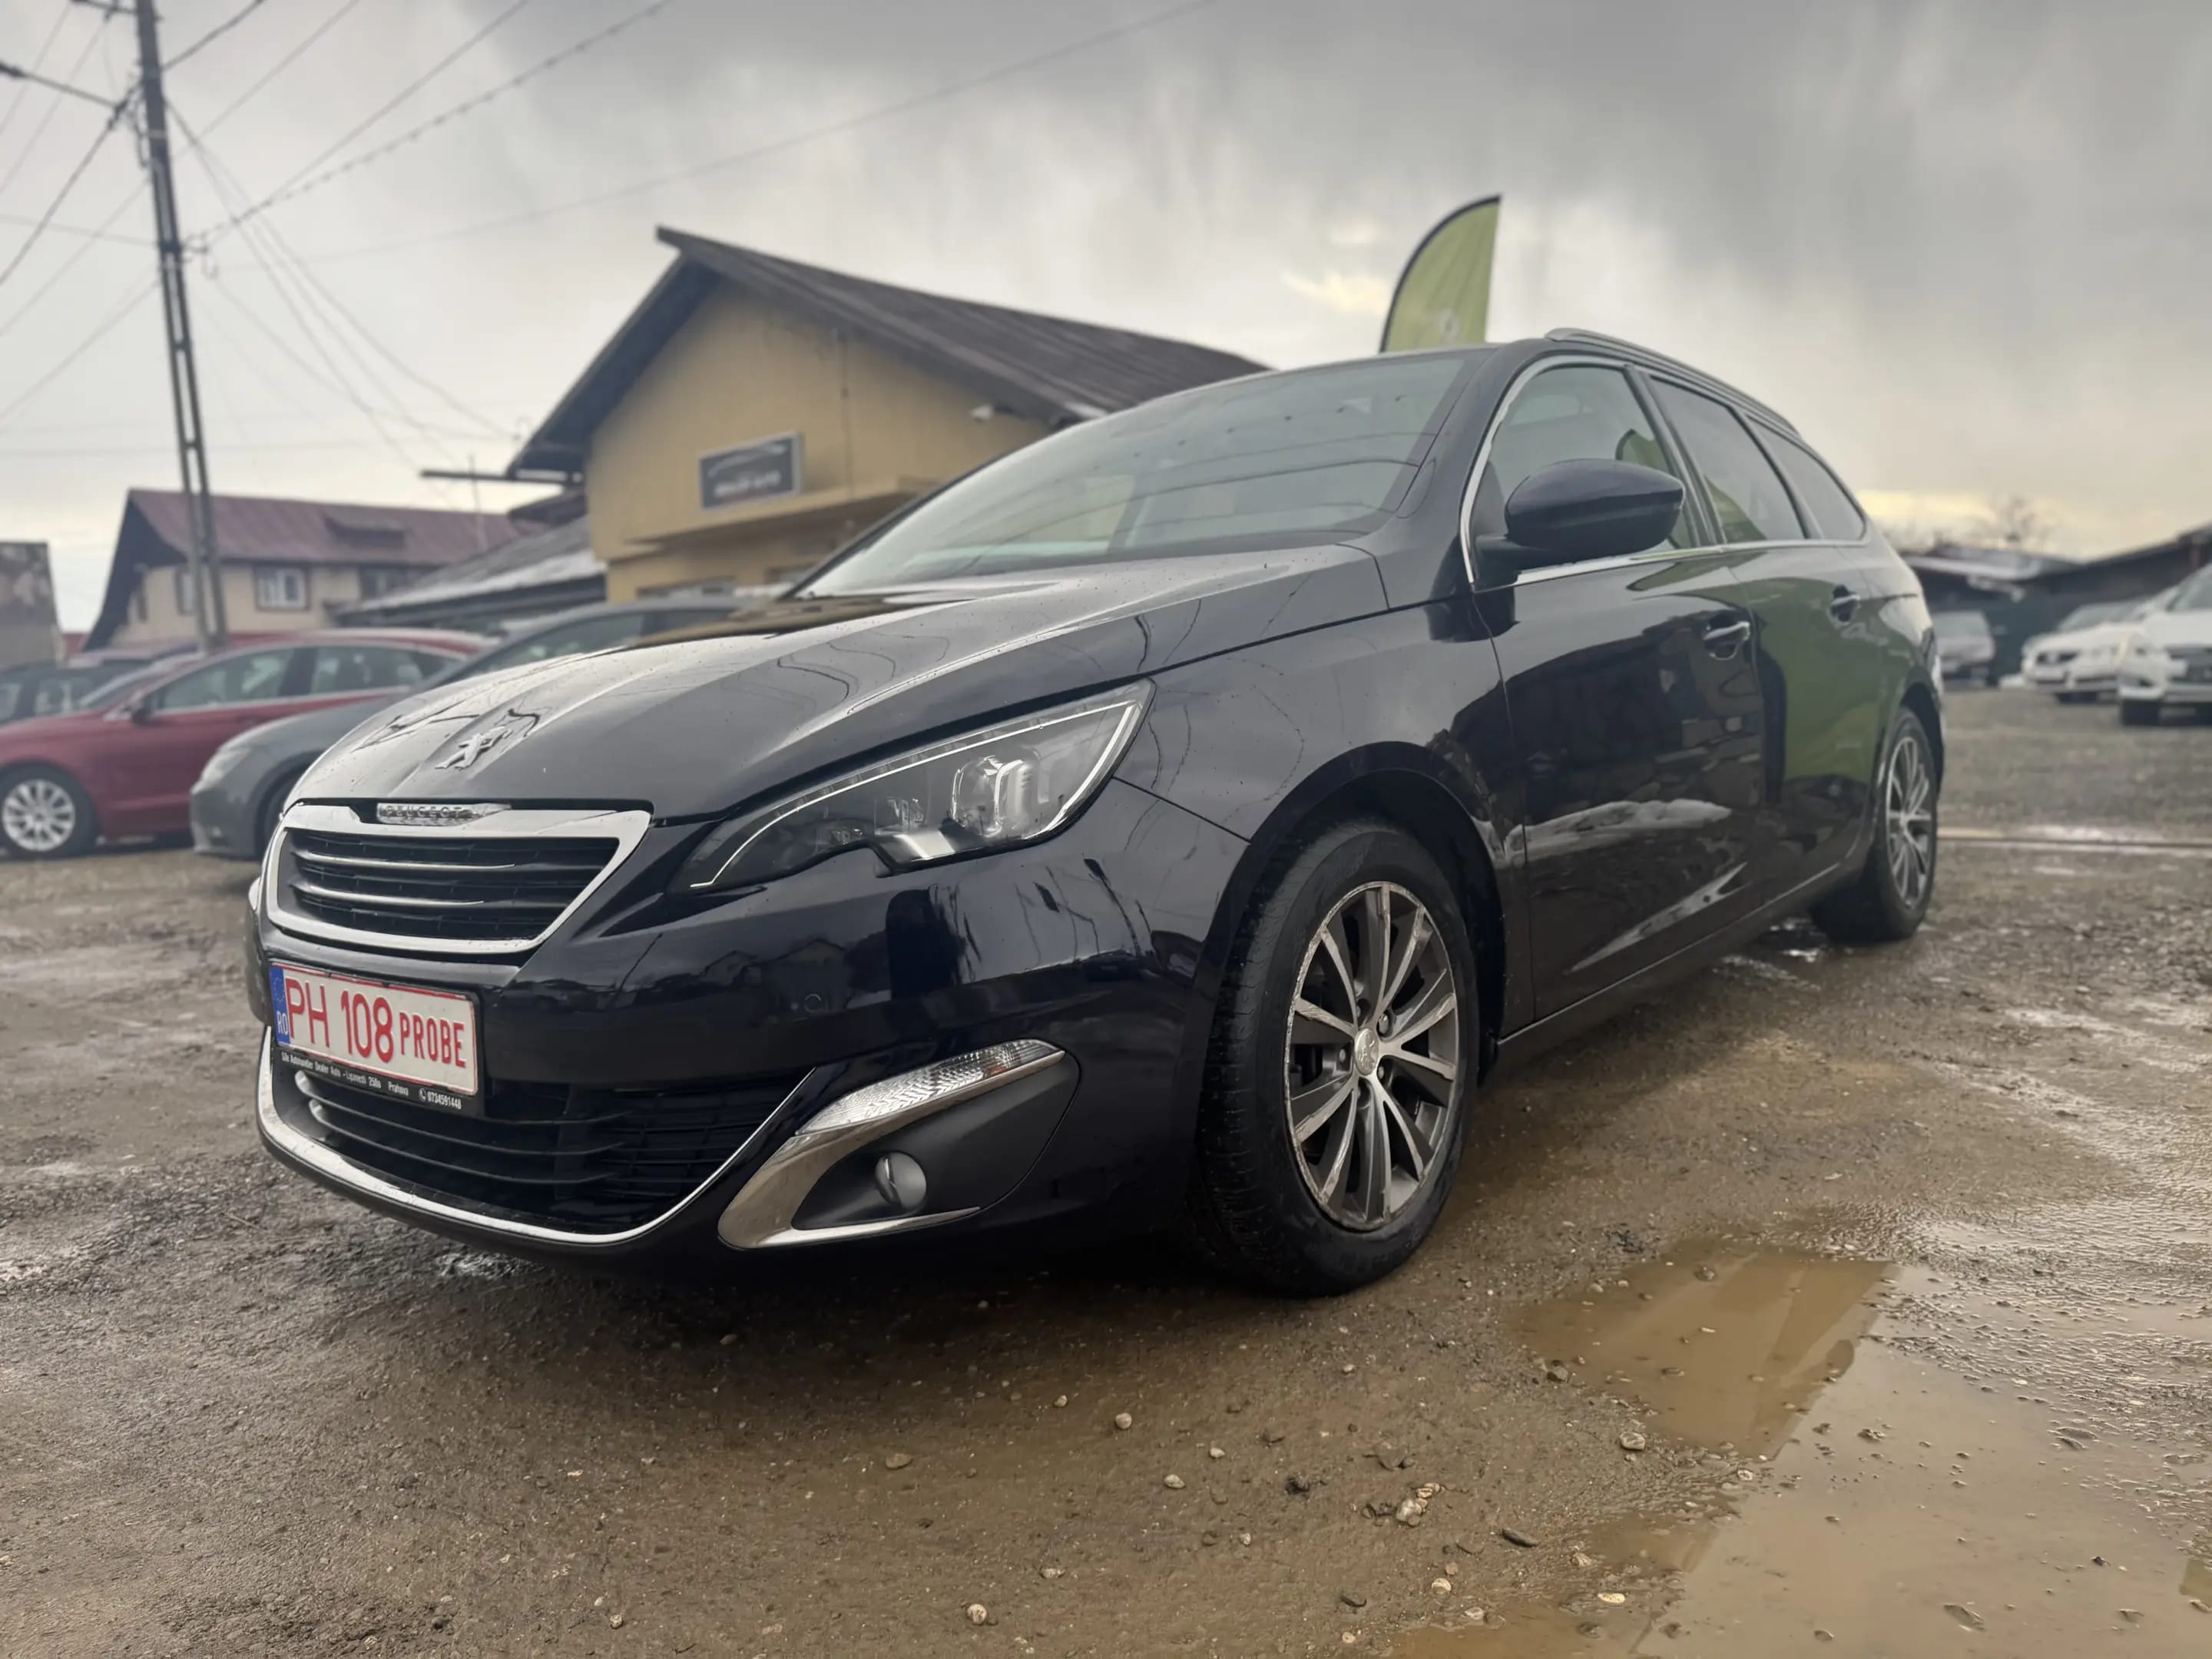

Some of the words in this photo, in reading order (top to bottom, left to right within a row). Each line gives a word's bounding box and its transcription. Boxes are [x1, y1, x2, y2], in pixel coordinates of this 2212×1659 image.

[386, 805, 463, 819] PEUGEOT
[276, 1010, 289, 1036] RO
[285, 977, 330, 1048] PH
[341, 989, 394, 1063] 108
[399, 1012, 467, 1068] PROBE
